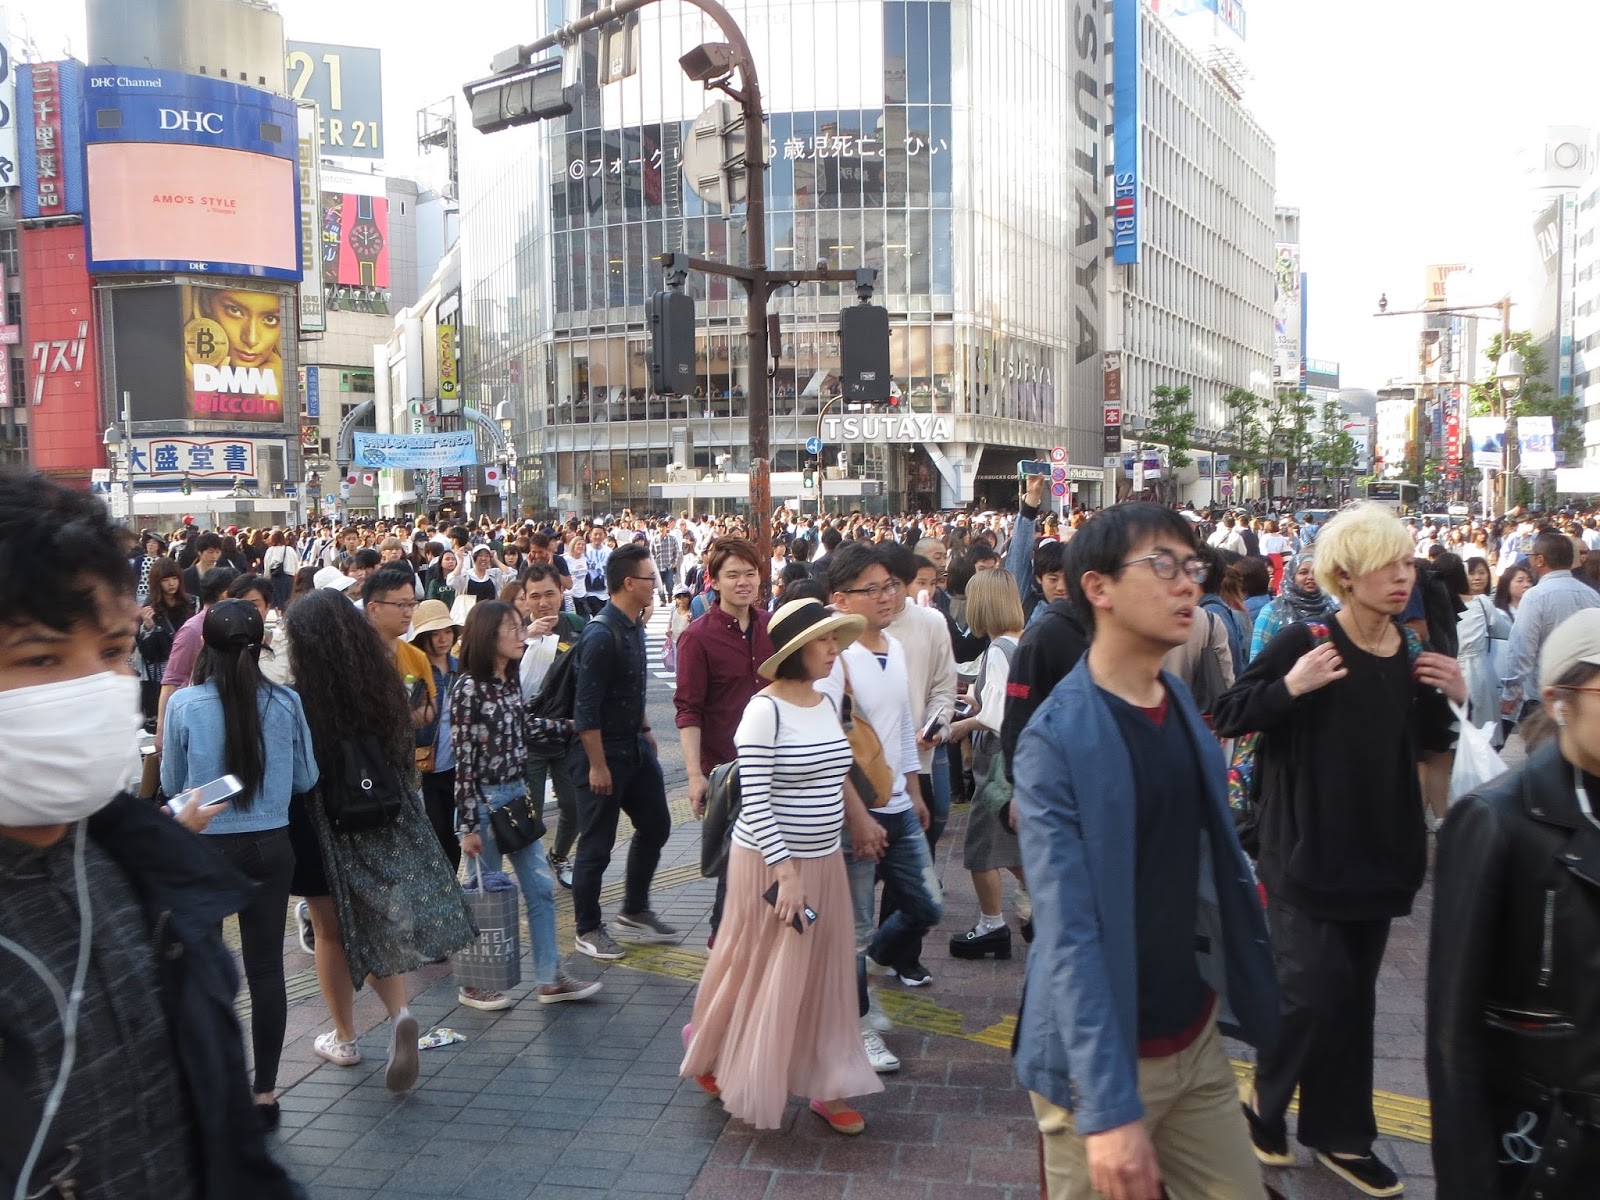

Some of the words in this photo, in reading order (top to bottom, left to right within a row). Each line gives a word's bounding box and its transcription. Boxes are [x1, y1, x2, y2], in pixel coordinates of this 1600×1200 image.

[91, 77, 115, 88] DHC
[117, 77, 162, 88] Channel
[286, 52, 341, 111] 21
[159, 109, 223, 134] DHC
[32, 68, 58, 206] 三千里薬品
[352, 121, 378, 149] 21
[1073, 0, 1097, 364] SUTAYA
[153, 194, 194, 204] AMO'S
[201, 197, 236, 208] STYLE
[1116, 173, 1135, 247] SEIBU
[189, 262, 208, 271] DHC
[32, 321, 89, 406] クスリ
[193, 363, 279, 395] DMM
[442, 382, 453, 391] 4F
[193, 392, 279, 414] Bitcoin
[824, 417, 950, 439] TSUTAYA
[1107, 410, 1118, 423] 本
[125, 445, 248, 472] 大盛堂書
[462, 942, 511, 956] GINZA
[480, 932, 499, 943] HE
